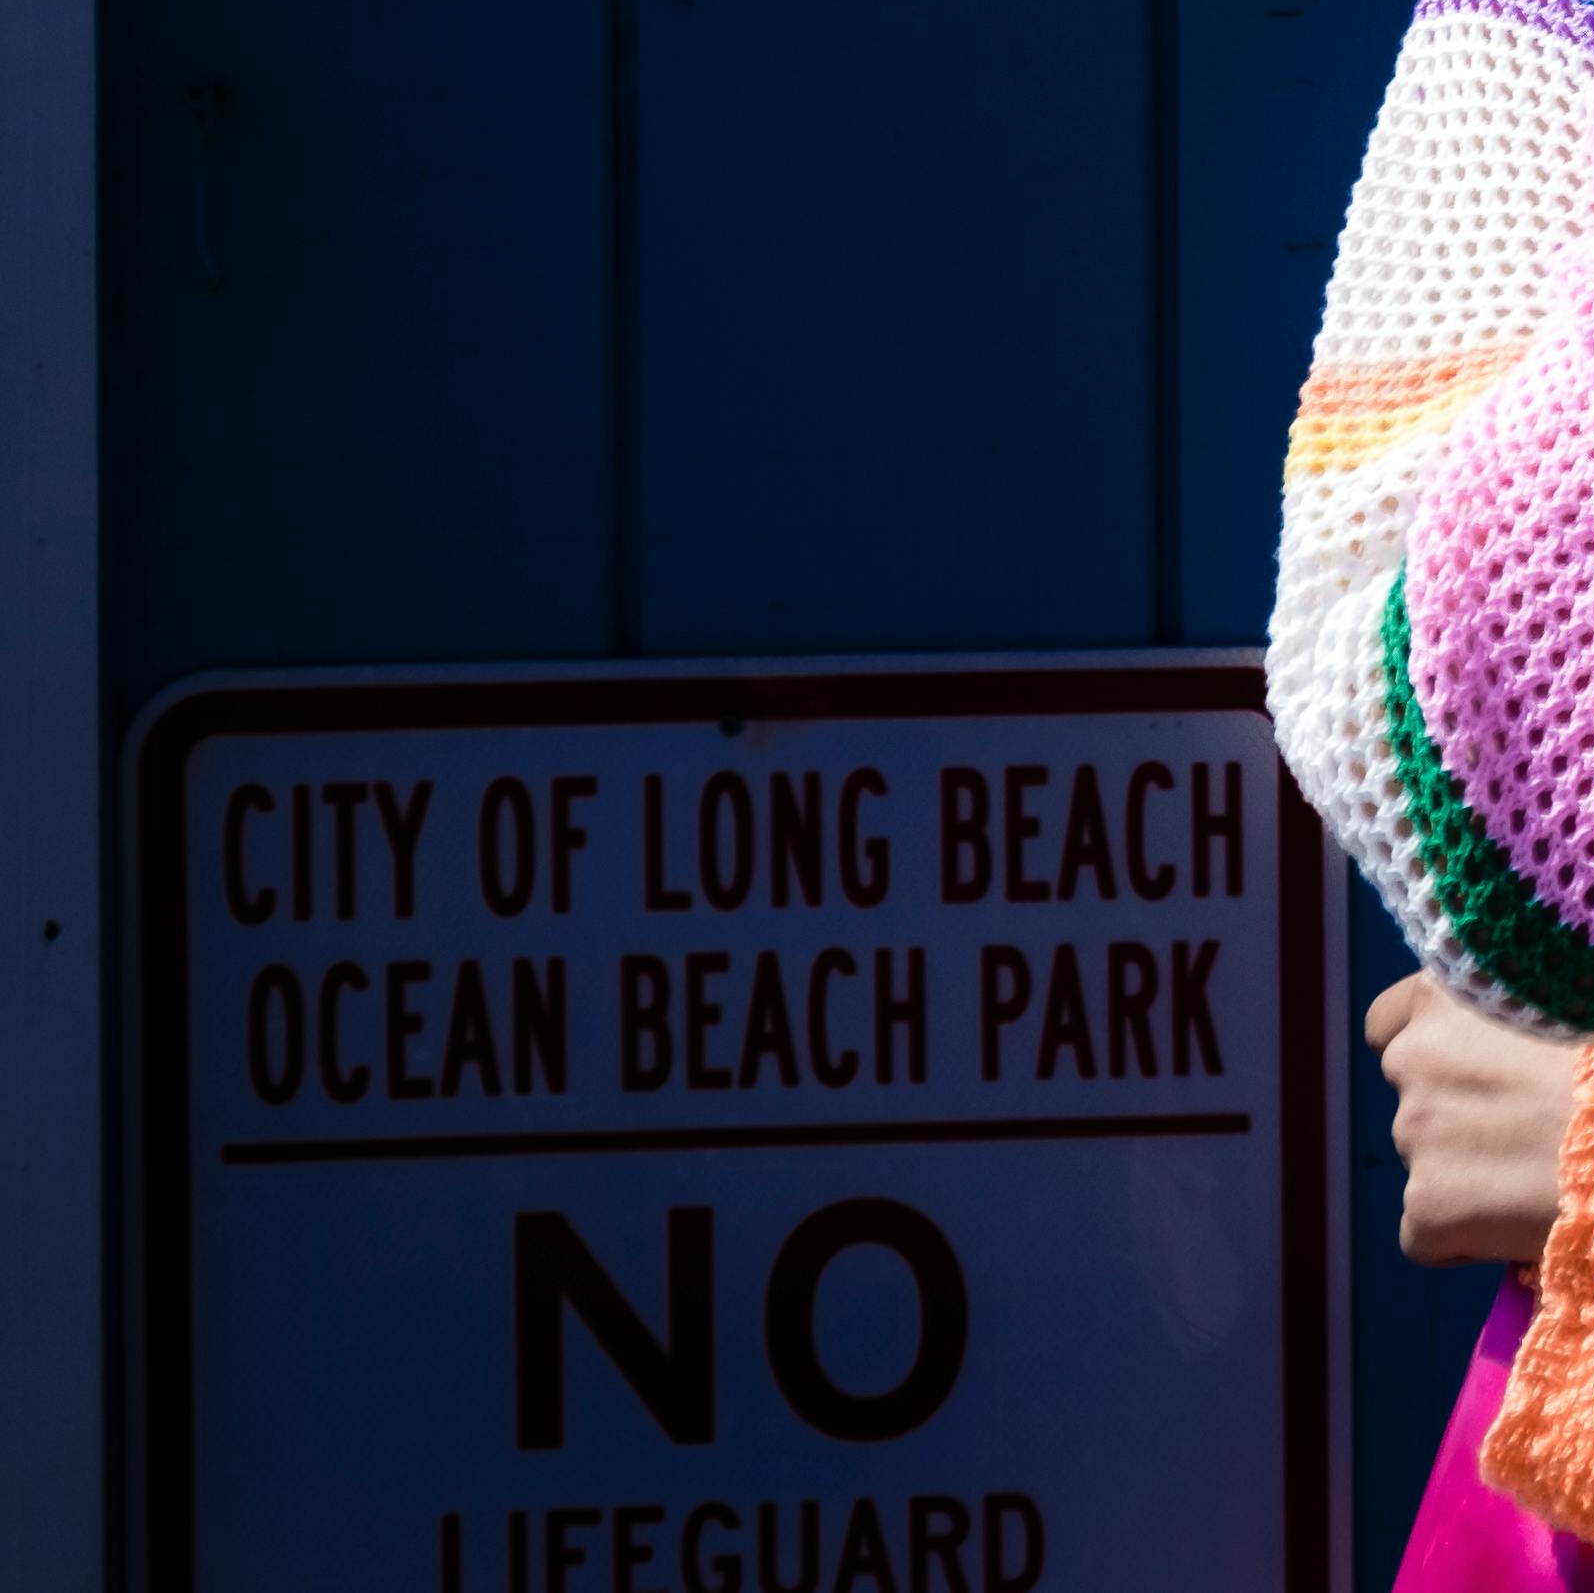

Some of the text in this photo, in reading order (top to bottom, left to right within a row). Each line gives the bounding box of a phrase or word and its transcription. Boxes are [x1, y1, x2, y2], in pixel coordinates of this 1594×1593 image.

[222, 761, 1246, 925] CITY OF LONG BEACH
[246, 938, 1226, 1105] OCEAN BEACH PARK
[511, 1196, 969, 1451] NO
[439, 1492, 1046, 1593] LIFEGUARD
